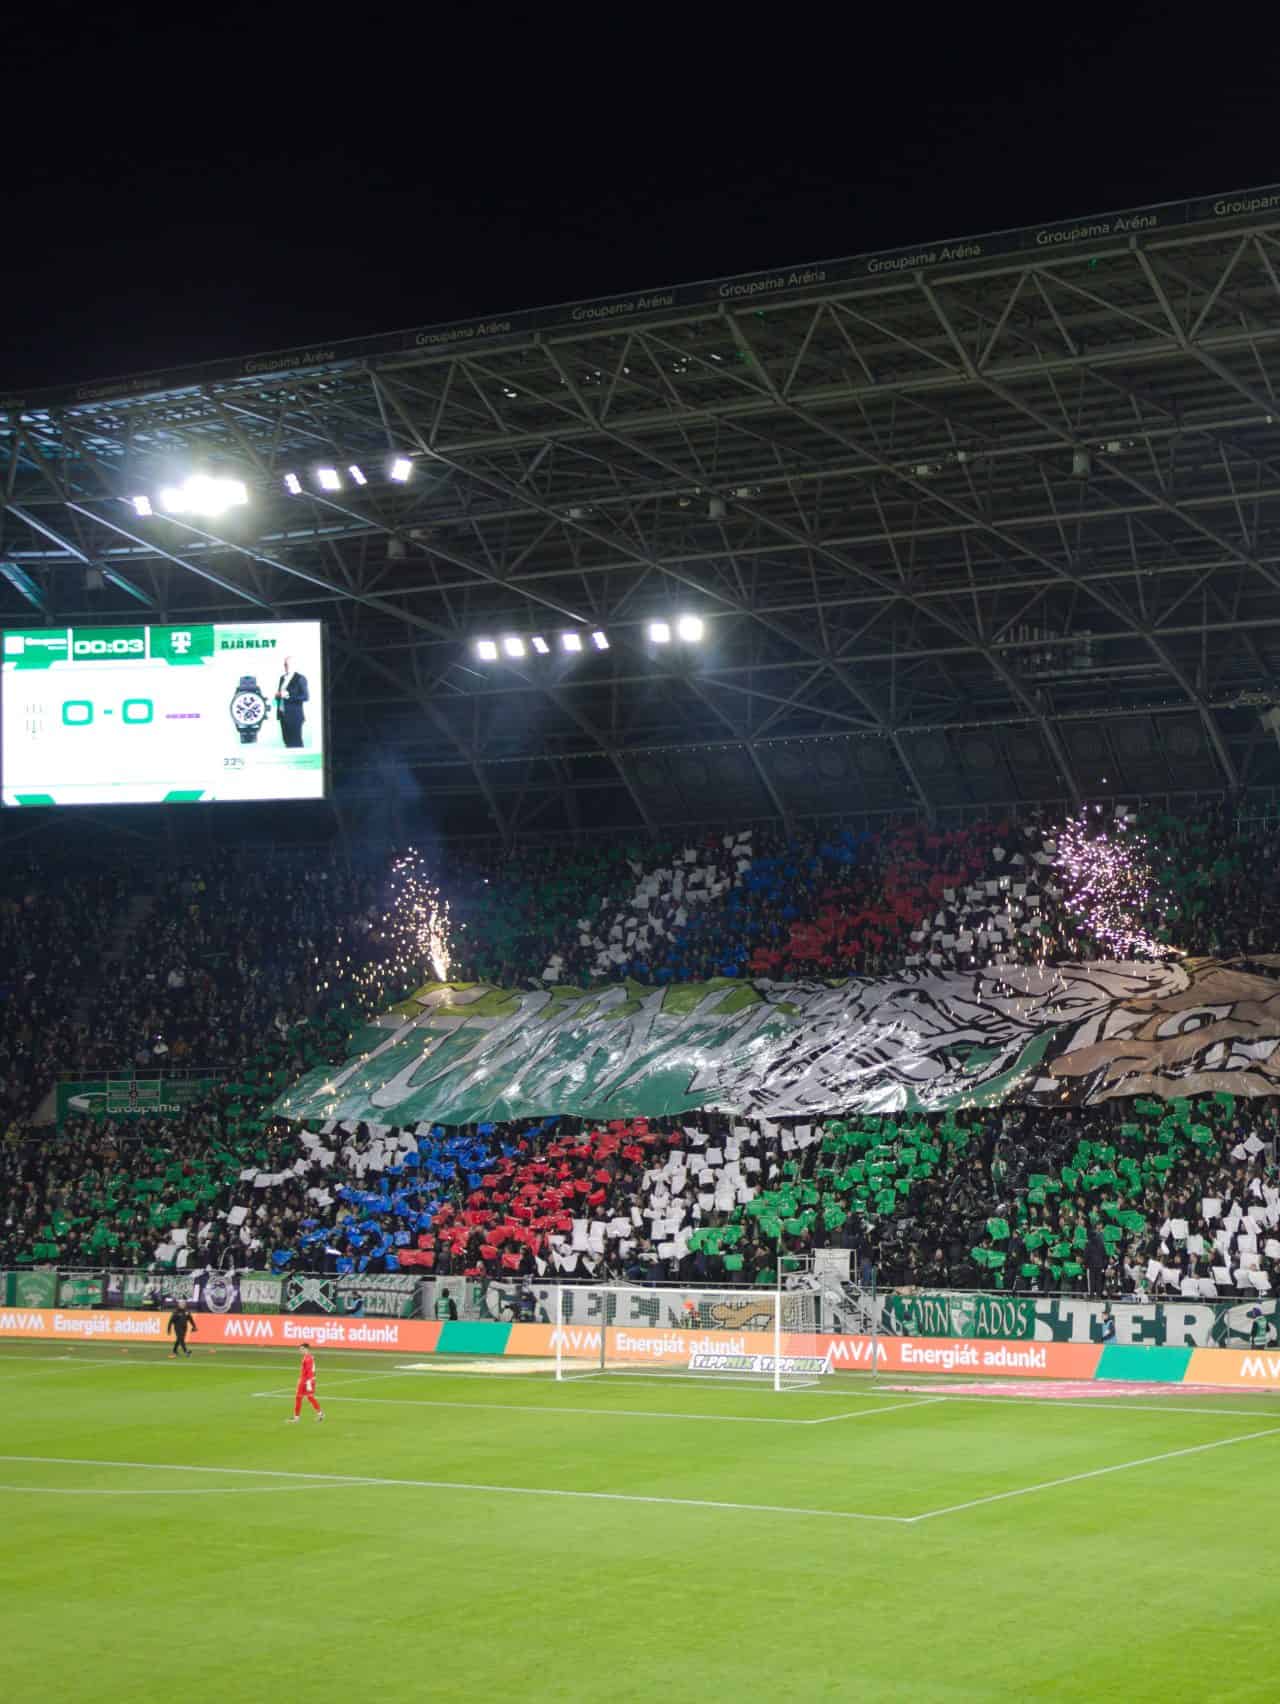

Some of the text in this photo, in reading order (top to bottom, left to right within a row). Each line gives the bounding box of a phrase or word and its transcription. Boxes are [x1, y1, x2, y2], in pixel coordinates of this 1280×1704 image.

[1036, 214, 1157, 245] Groupama Aréna
[868, 243, 981, 273] Groupama Aréna
[719, 268, 826, 297] Groupama Aréna
[572, 301, 635, 320] Groupama
[74, 639, 144, 654] 00:03
[0, 1314, 45, 1329] MVM
[115, 1318, 160, 1334] adunk!
[224, 1320, 398, 1344] MVM Energiát adunk!
[828, 1341, 1046, 1368] MVM Energiát adunk!
